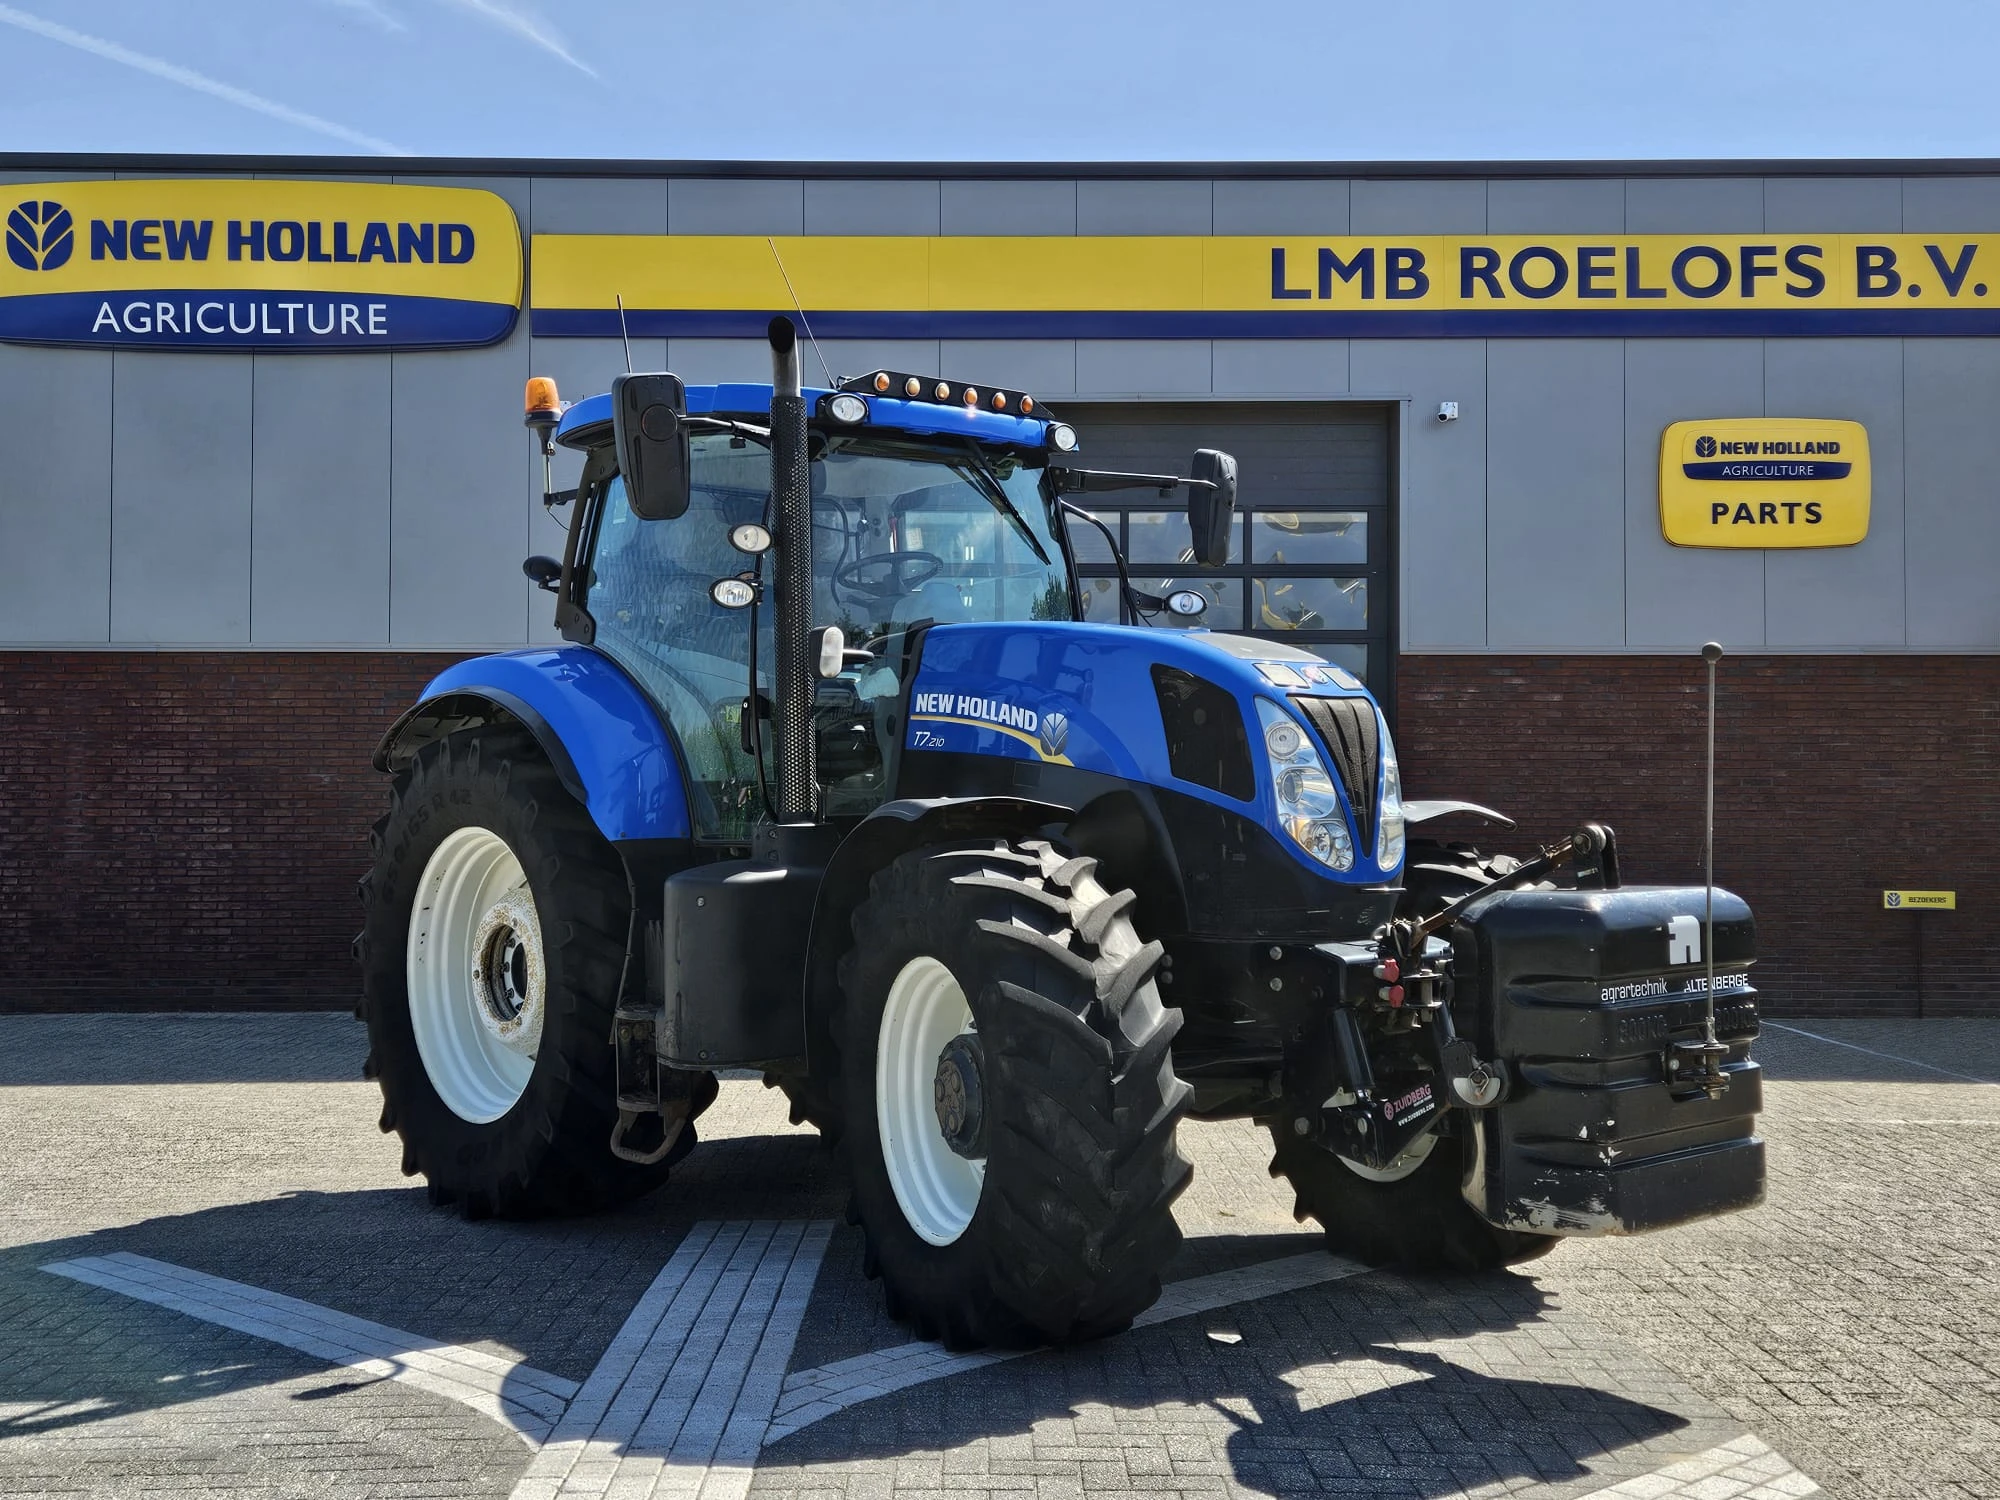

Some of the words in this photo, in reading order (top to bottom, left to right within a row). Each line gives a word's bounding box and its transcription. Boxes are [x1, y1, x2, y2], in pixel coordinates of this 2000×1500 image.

[90, 219, 214, 261] NEW
[227, 221, 476, 265] HOLLAND
[1271, 247, 1430, 301] LMB
[1460, 244, 1827, 300] ROELOFS
[1856, 243, 1988, 299] B.V.
[92, 301, 388, 336] AGRICULTURE
[1720, 442, 1759, 454] NEW
[1763, 442, 1840, 454] HOLLAND
[1722, 465, 1815, 476] AGRICULTURE
[1712, 502, 1823, 525] PARTS
[915, 693, 955, 714] NEW
[957, 695, 1038, 732] HOLLAND
[913, 731, 945, 747] T7.210
[1601, 976, 1668, 1004] agrartechnik
[1394, 1083, 1432, 1113] ZUIDBERG
